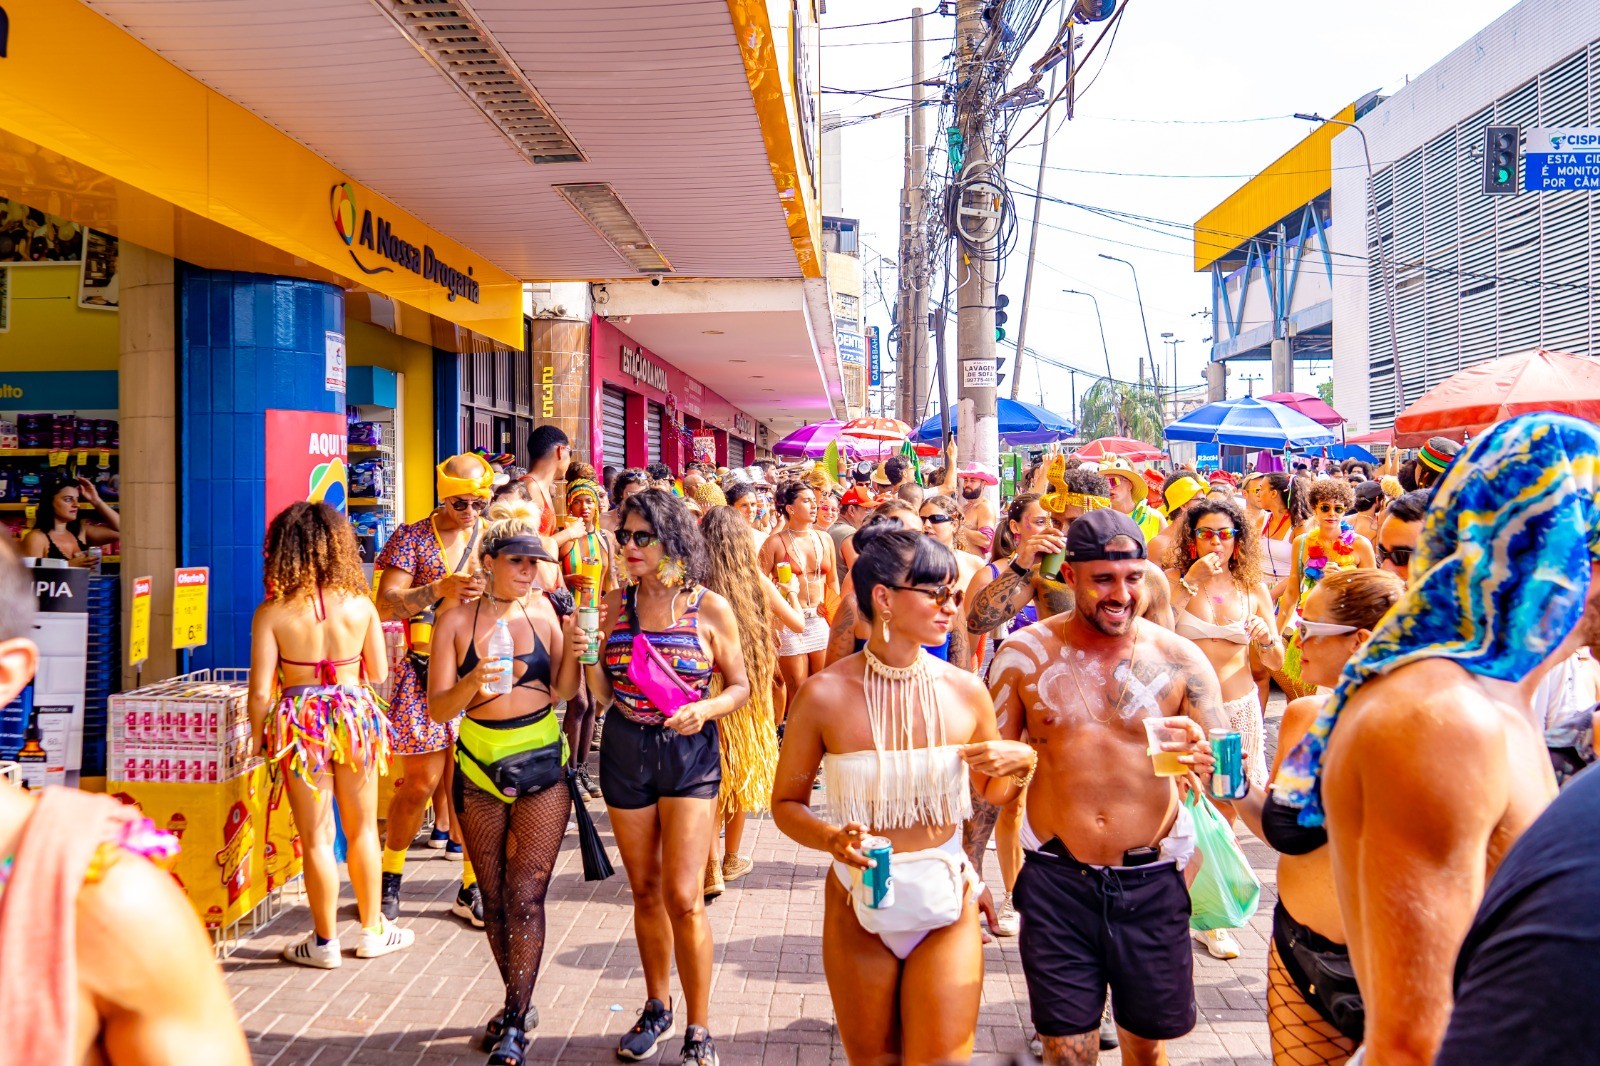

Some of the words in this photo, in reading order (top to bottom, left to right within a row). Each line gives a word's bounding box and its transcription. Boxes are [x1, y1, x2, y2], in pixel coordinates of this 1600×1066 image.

[1567, 135, 1600, 145] CISP
[1547, 154, 1577, 164] ESTA
[1541, 165, 1549, 176] É
[1543, 178, 1566, 188] POR
[359, 210, 374, 250] A
[377, 217, 421, 275] Nossa
[424, 245, 480, 304] Drogaria
[0, 383, 23, 399] lto
[308, 432, 340, 457] AQUI
